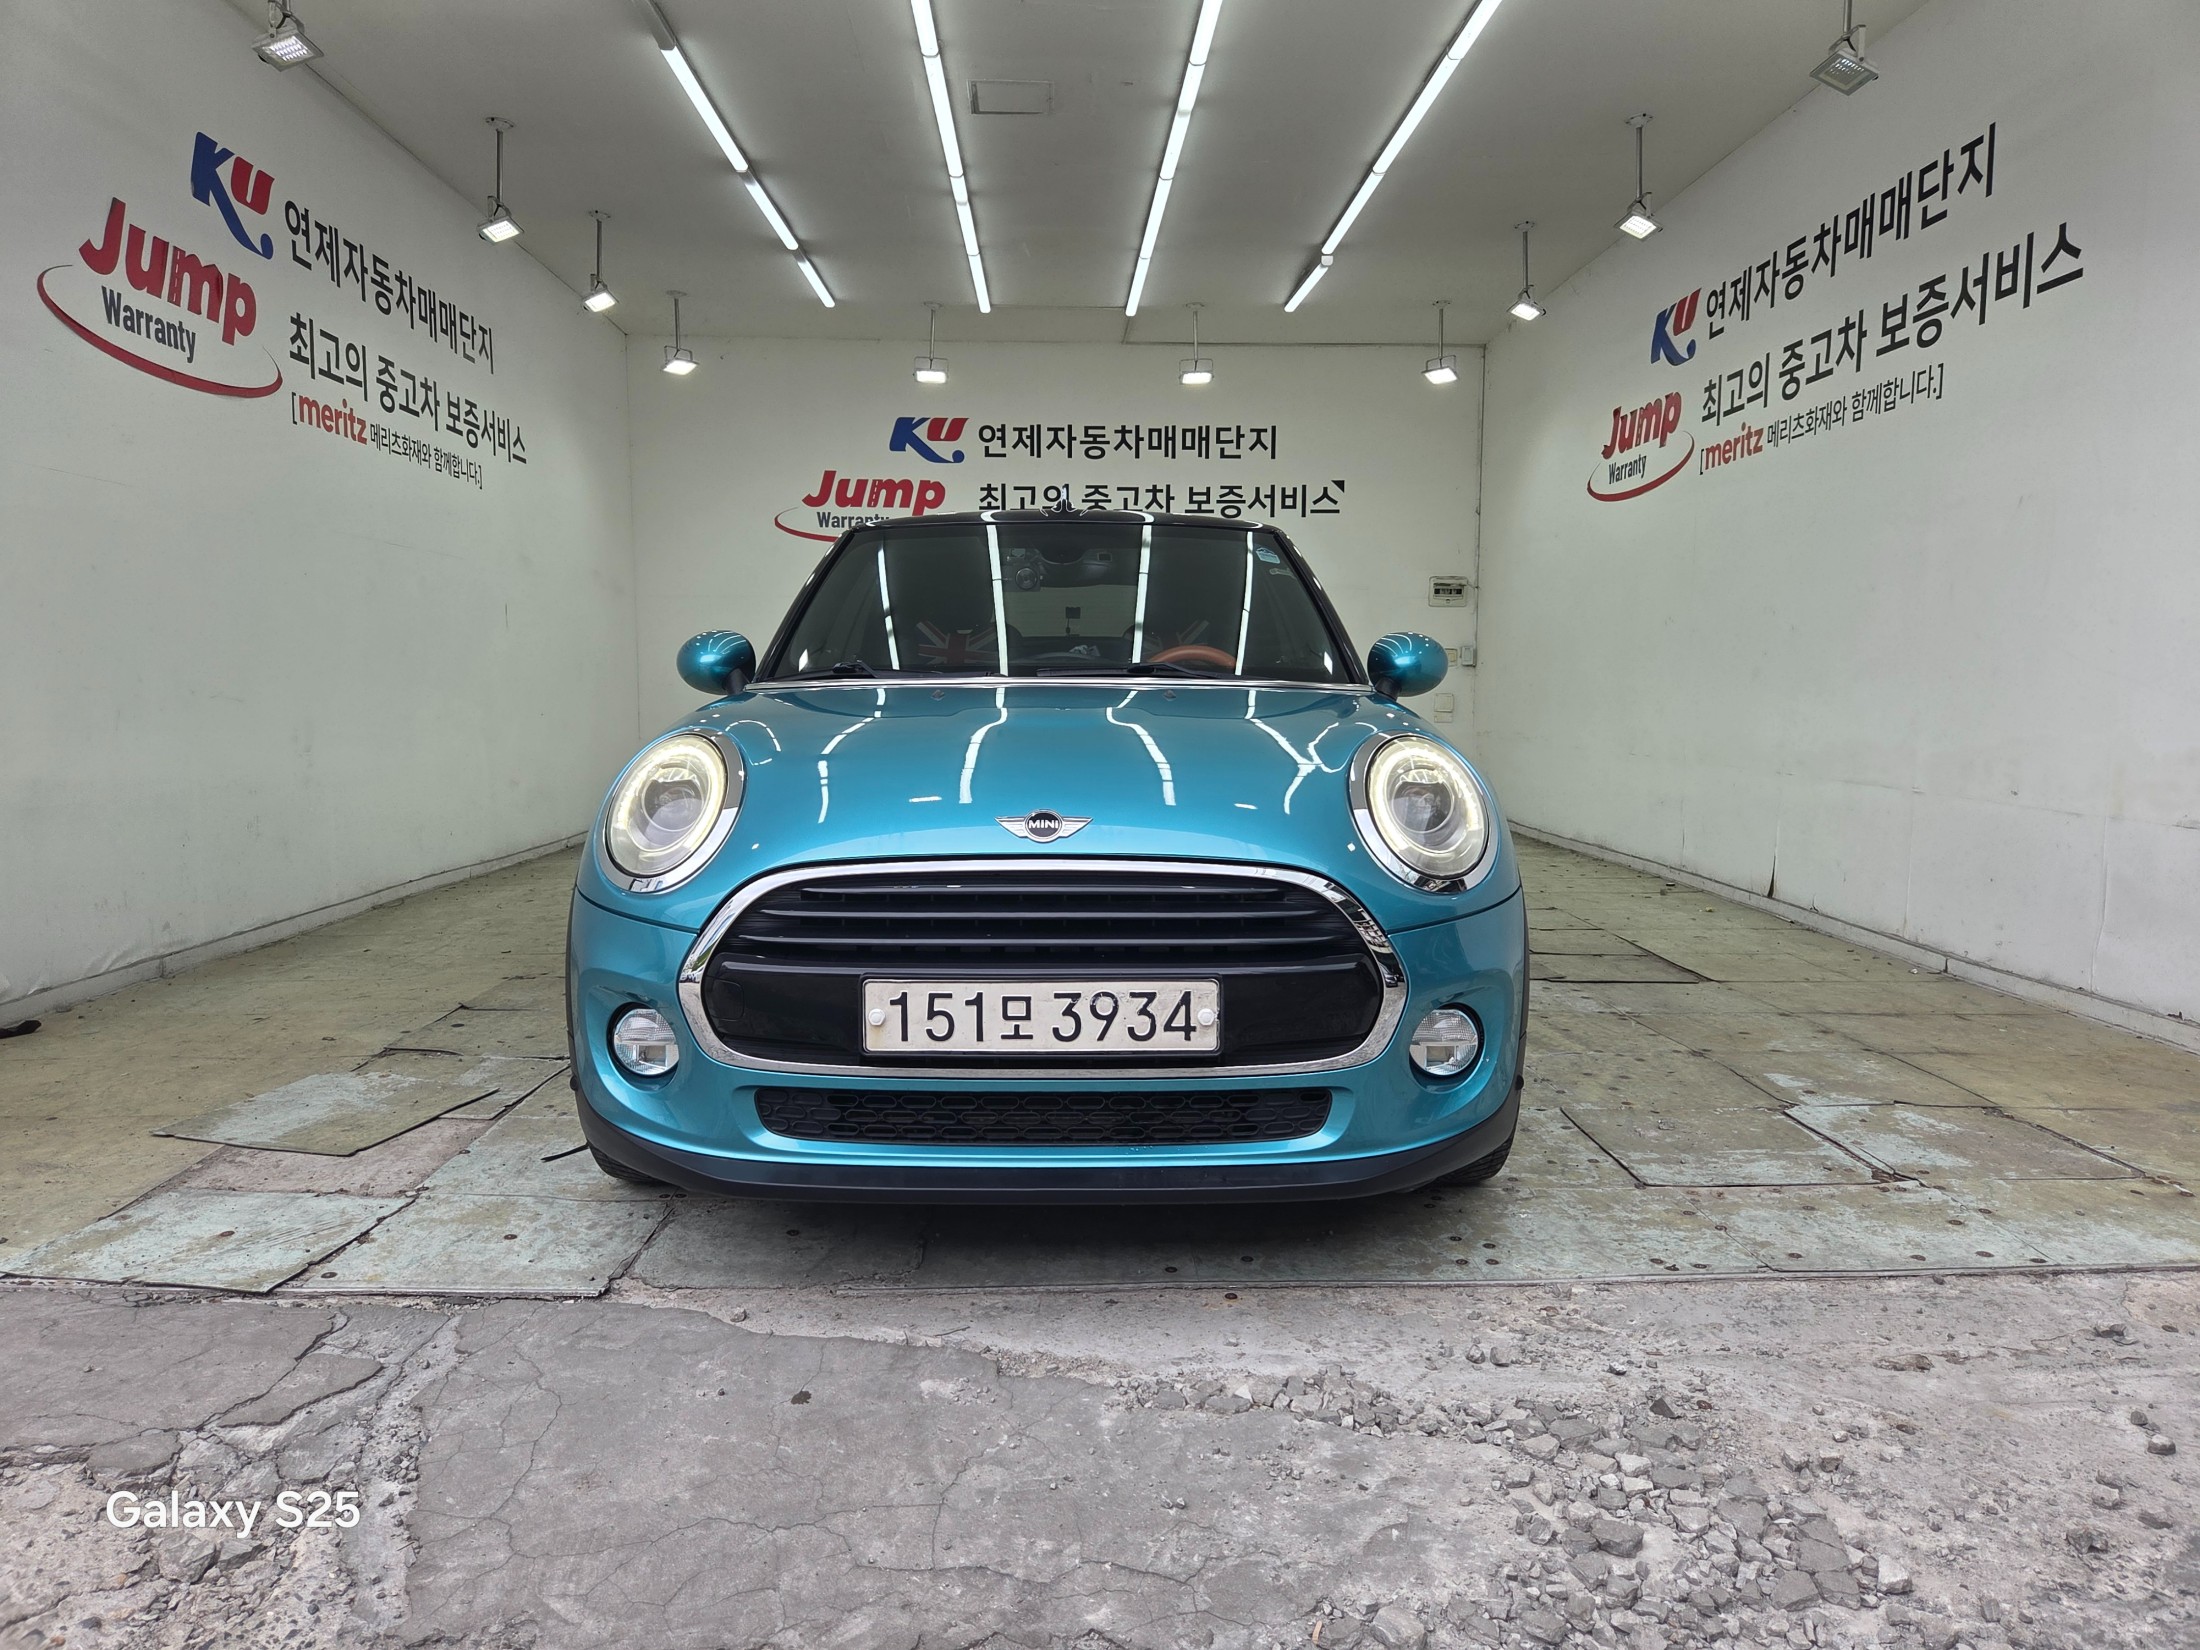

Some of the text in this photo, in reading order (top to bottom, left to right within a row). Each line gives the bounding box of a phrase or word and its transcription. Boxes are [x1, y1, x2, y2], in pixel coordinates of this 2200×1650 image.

[1705, 122, 1997, 340] 연제자동차매매단지
[78, 196, 258, 346] Jump
[284, 200, 494, 375] 연제자동차매매단지
[101, 285, 197, 364] Warranty
[1701, 222, 2085, 427] 최고의 중고차 보증서비스
[289, 311, 528, 464] 최고의 중고차 보증서비스
[1766, 396, 1848, 448] 메리츠화재와
[1851, 362, 1944, 423] 함께합니다.]
[370, 423, 432, 470] 메리츠화재와
[433, 446, 483, 490] 함께합니다.]
[978, 423, 1278, 460] 연제자동차매매단지
[1601, 391, 1682, 460] Jump
[801, 469, 946, 516] Jump
[1081, 483, 1175, 514] 중고차
[1184, 484, 1340, 519] 보증서비스
[1608, 454, 1648, 486] Warranty
[1028, 820, 1059, 829] MINI
[1052, 990, 1197, 1043] 3934
